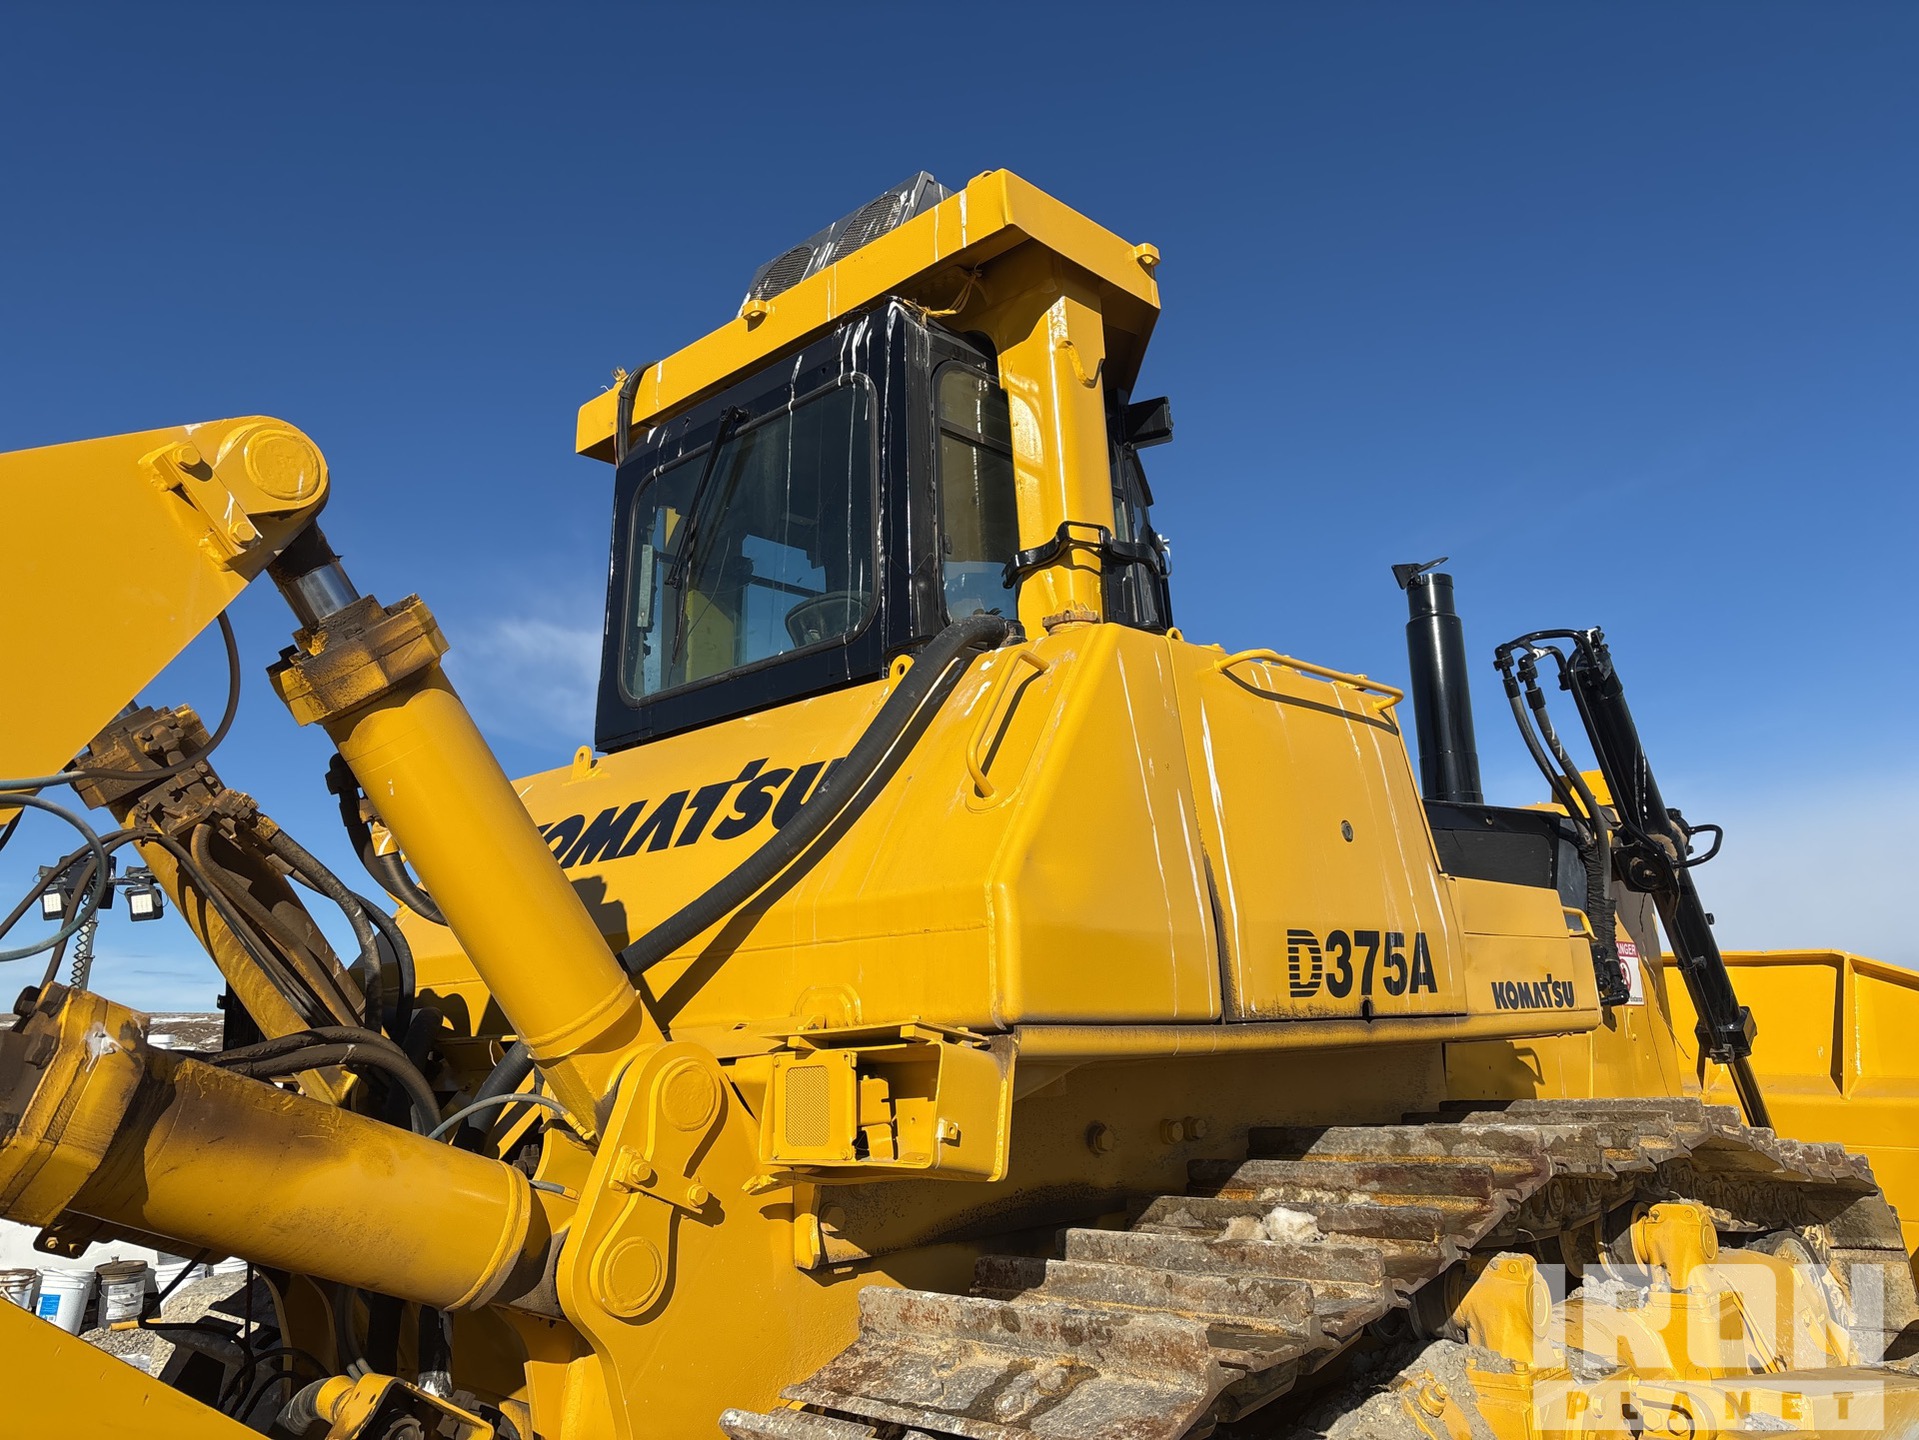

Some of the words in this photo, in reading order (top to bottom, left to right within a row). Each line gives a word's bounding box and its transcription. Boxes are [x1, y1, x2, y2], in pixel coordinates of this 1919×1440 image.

[537, 757, 846, 869] OMATSU
[1287, 929, 1438, 999] D375A
[1616, 943, 1637, 956] ANGER
[1491, 973, 1575, 1010] KOMATSU
